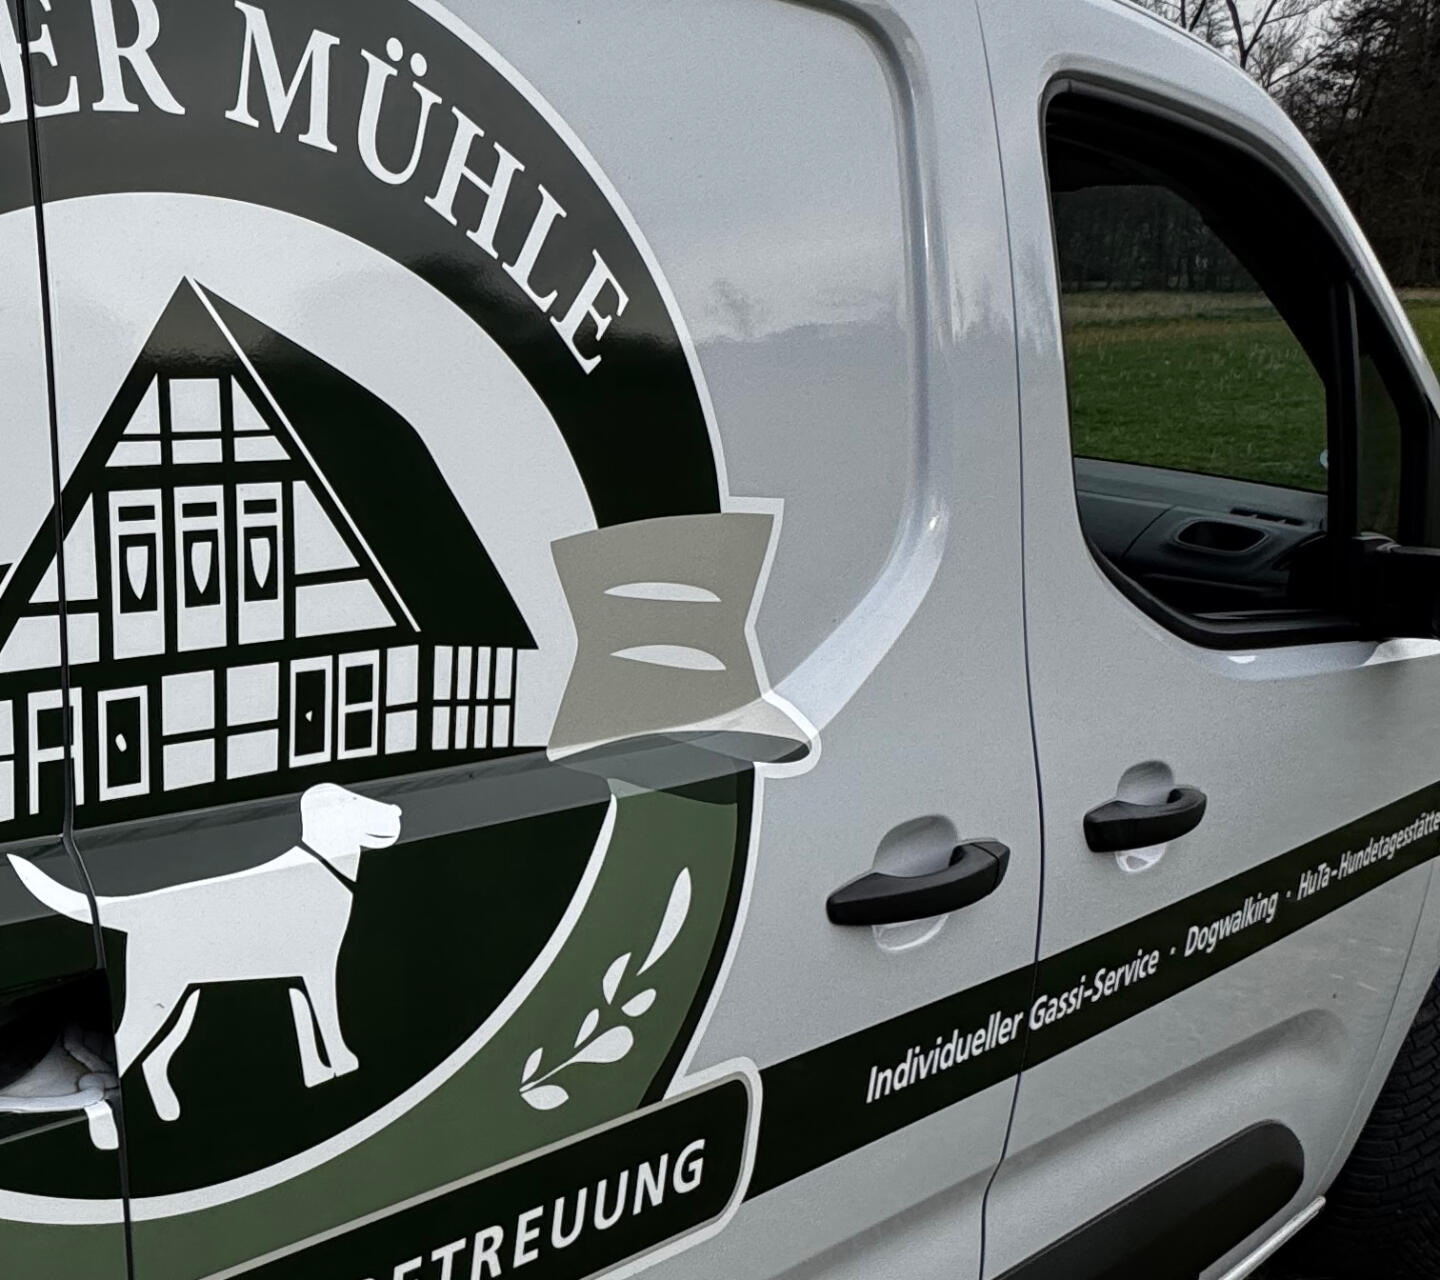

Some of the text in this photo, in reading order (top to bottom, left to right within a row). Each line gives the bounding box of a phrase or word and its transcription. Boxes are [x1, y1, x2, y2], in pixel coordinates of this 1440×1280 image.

[224, 0, 630, 376] MÜHLE
[865, 1008, 1023, 1104] Individueller
[1028, 946, 1160, 1031] Gassi-Service
[1183, 888, 1279, 957] Dogwalking
